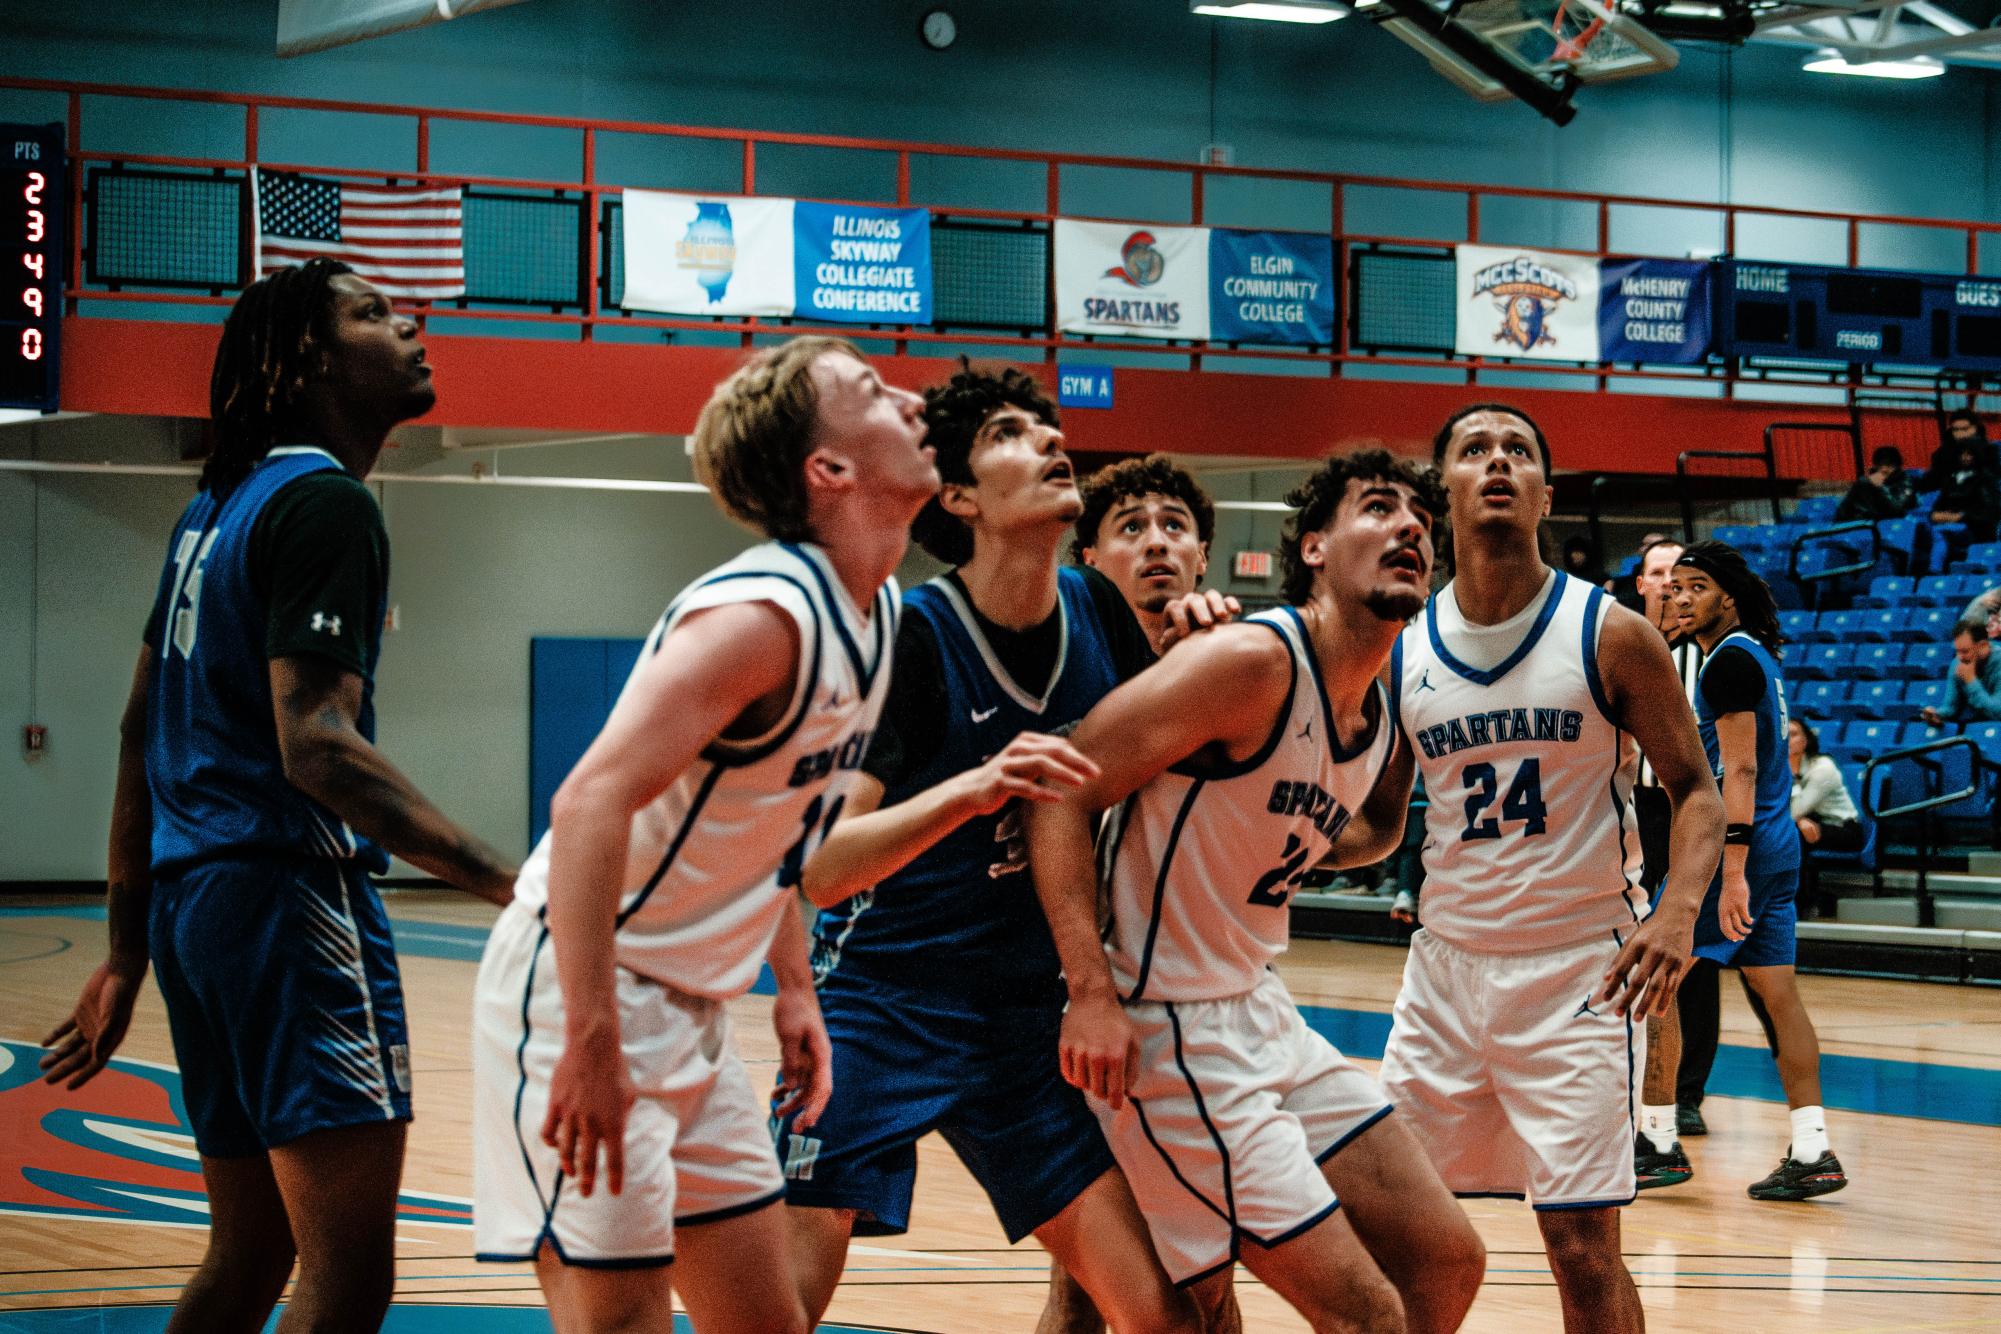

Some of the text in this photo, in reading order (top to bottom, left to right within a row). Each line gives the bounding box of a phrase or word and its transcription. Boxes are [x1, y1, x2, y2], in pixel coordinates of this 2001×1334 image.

[14, 141, 41, 160] PTS
[25, 172, 45, 204] 2
[27, 210, 44, 242] 3
[832, 215, 901, 240] ILLINOIS
[830, 239, 902, 263] SKYWAY
[24, 253, 43, 279] 4
[816, 263, 915, 288] COLLEGIATE
[1249, 255, 1294, 276] ELGIN
[1223, 277, 1318, 299] COMMUNITY
[1620, 276, 1690, 298] McHENRY
[1735, 266, 1790, 293] HOME
[23, 287, 43, 317] 9
[812, 287, 921, 313] CONFERENCE
[1955, 281, 2001, 308] GUES
[1083, 297, 1180, 324] SPARTANS
[1239, 302, 1305, 323] COLLEGE
[1625, 300, 1685, 321] COUNTY
[22, 328, 42, 360] 0
[1624, 322, 1686, 344] COLLEGE
[1836, 330, 1882, 350] PERIOD
[1061, 375, 1109, 397] GYM A
[1415, 707, 1583, 760] SPARTANS
[1461, 757, 1548, 842] 24
